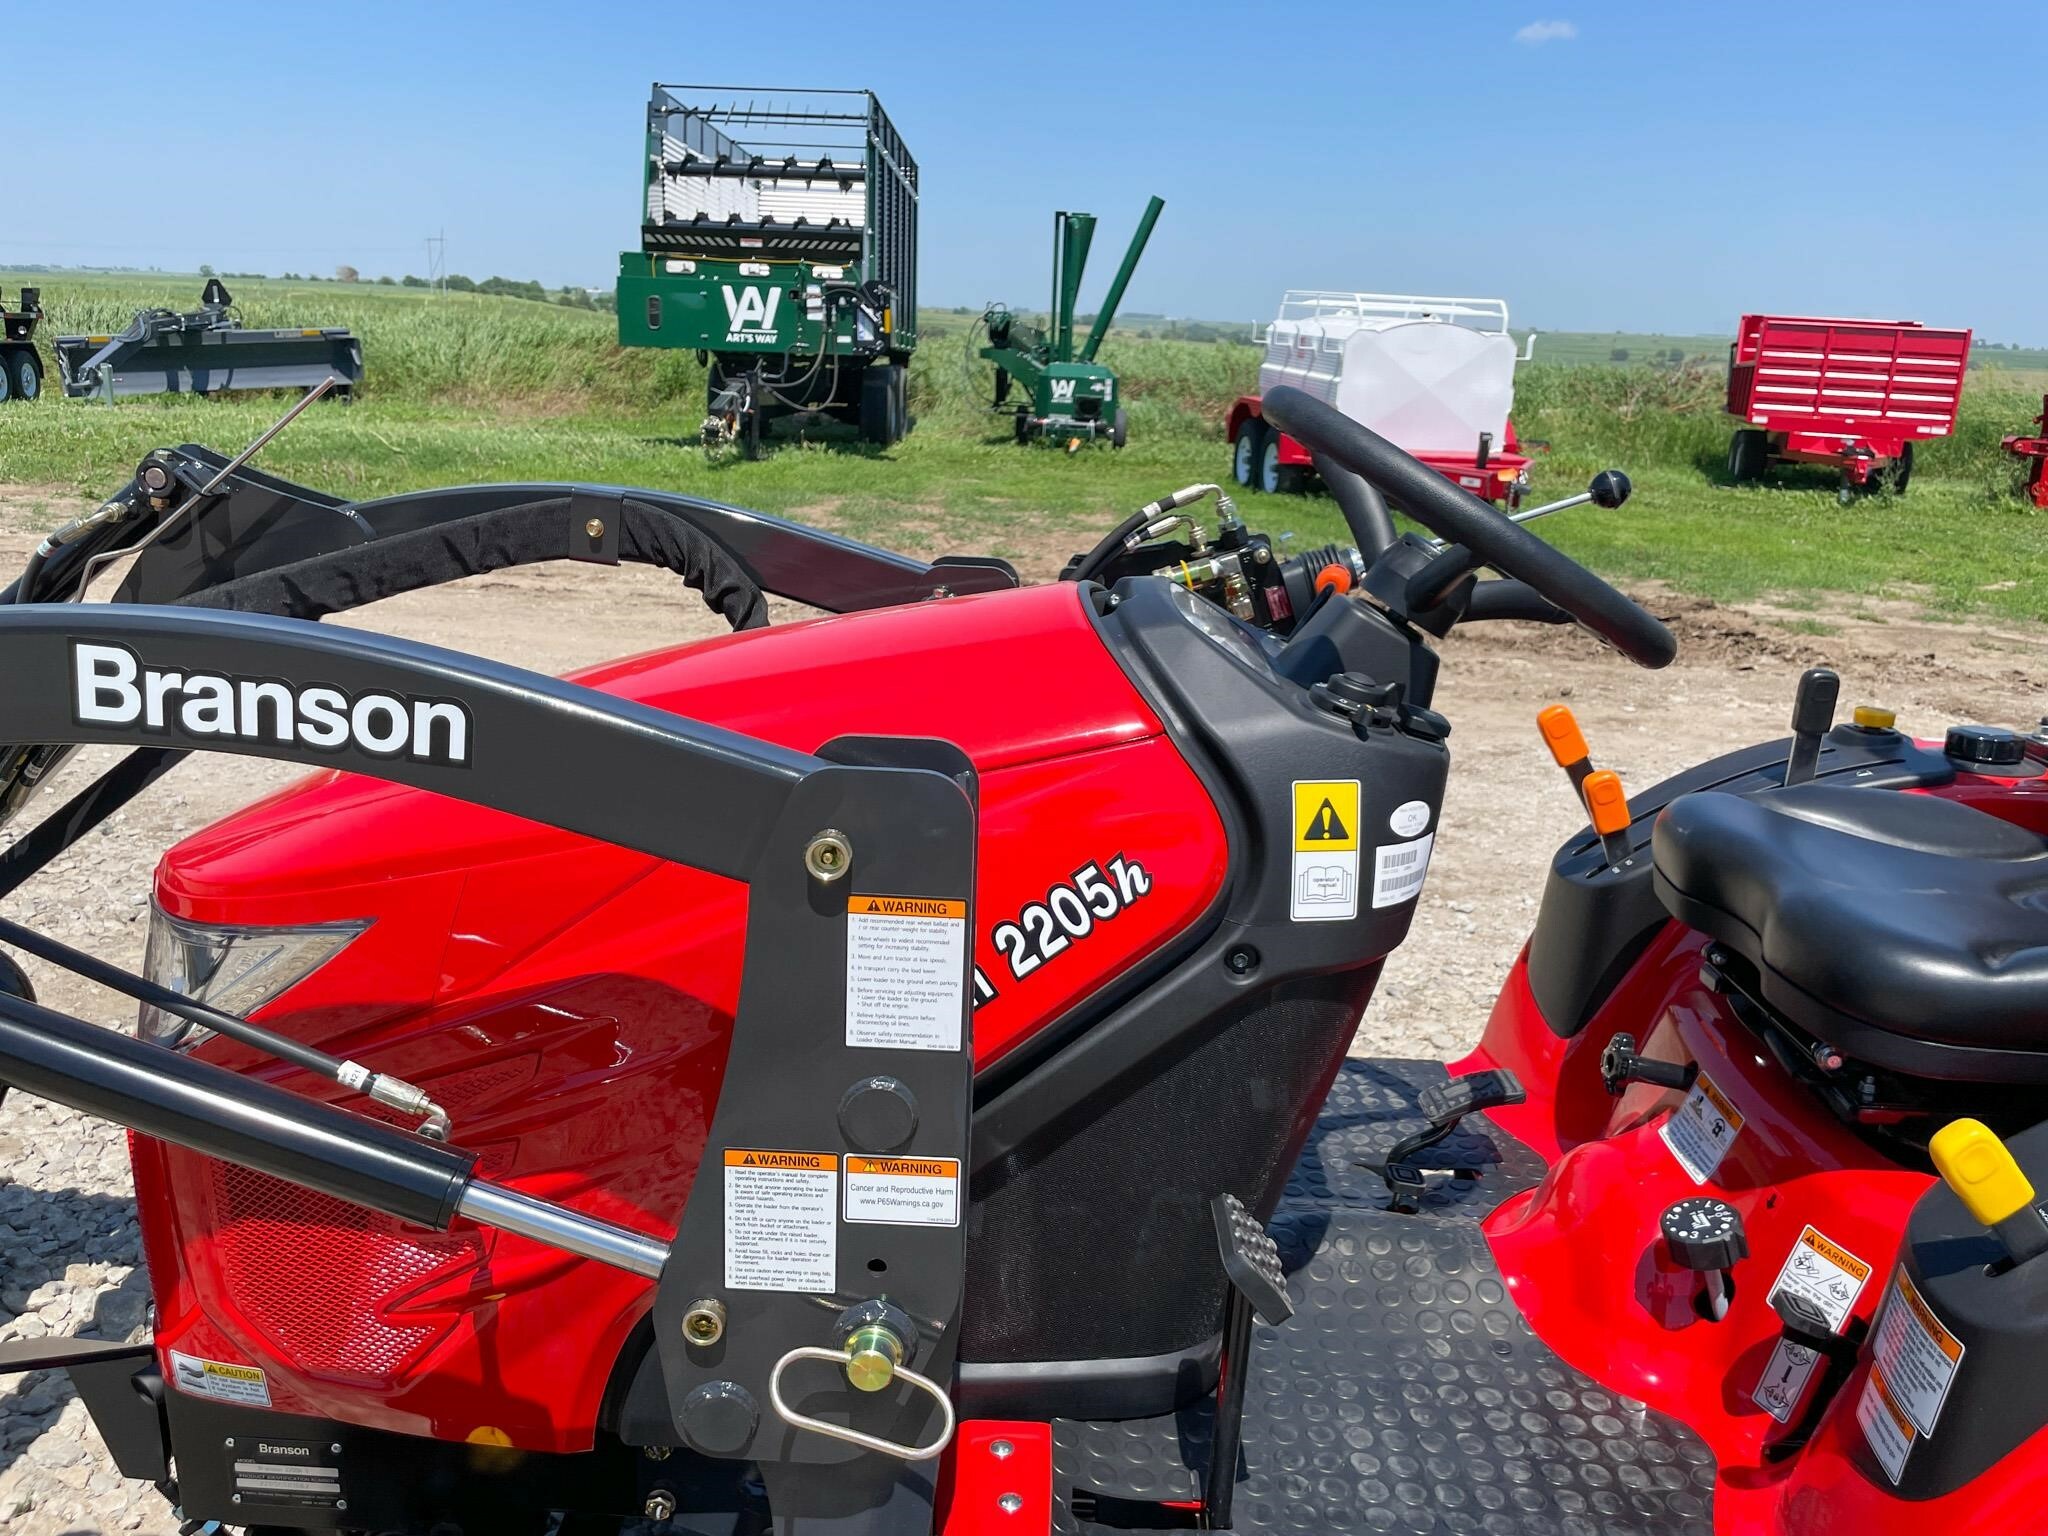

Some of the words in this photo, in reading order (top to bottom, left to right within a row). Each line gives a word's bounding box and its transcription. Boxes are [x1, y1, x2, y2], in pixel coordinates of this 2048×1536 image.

[726, 332, 754, 343] ART'S
[754, 334, 778, 344] WAY
[75, 643, 466, 761] Branson
[882, 900, 947, 914] WARNING
[994, 857, 1151, 979] 2205h
[758, 1154, 820, 1167] WARNING
[880, 1162, 942, 1174] WARNING
[850, 1183, 873, 1191] Cancer
[890, 1185, 932, 1195] Reproductive
[935, 1187, 953, 1195] Harm
[1689, 1230, 1700, 1239] 3
[1816, 1241, 1864, 1278] WARNING
[218, 1366, 260, 1380] CAUTION
[258, 1443, 310, 1456] Branson
